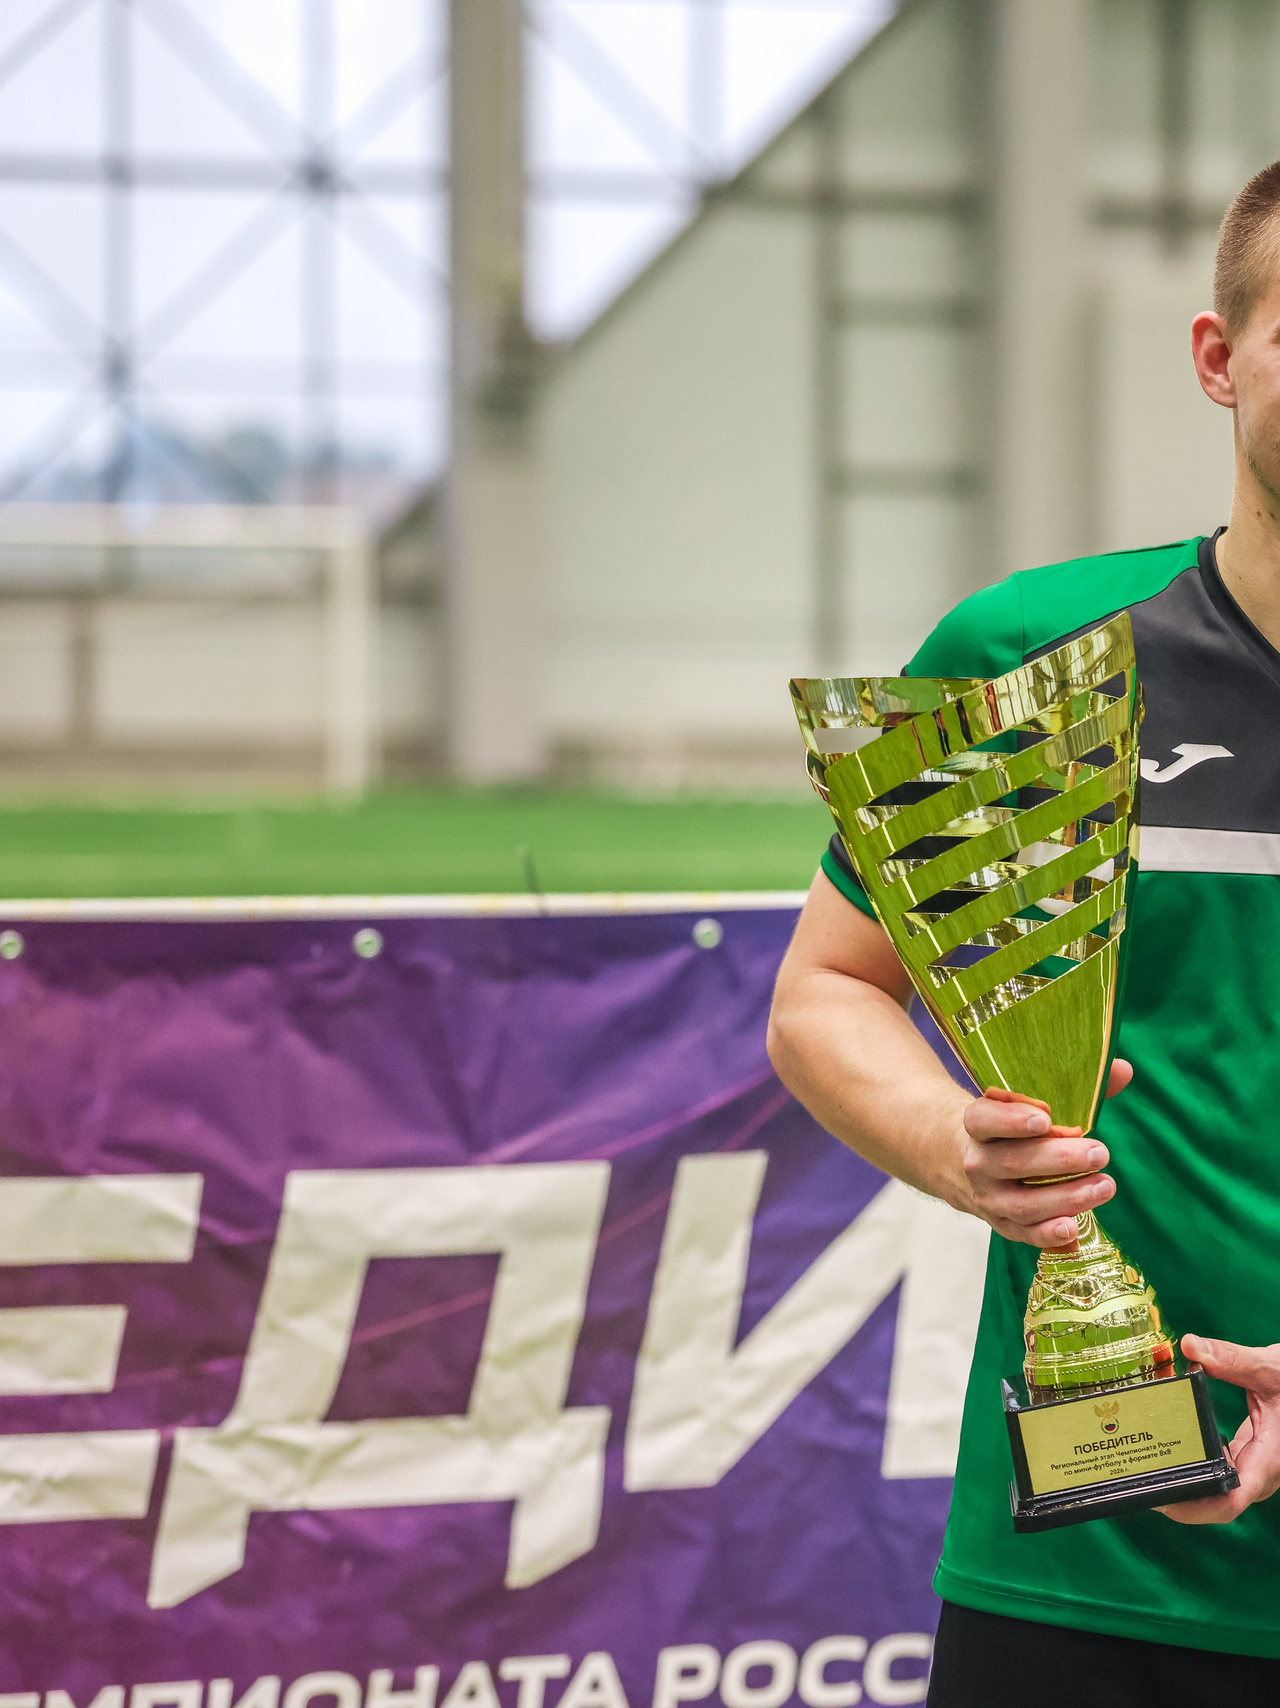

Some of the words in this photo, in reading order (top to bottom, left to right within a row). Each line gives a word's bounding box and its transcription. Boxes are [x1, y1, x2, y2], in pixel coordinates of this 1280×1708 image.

[1050, 1455, 1099, 1470] Региональный
[1099, 1453, 1115, 1461] этап
[1116, 1445, 1157, 1457] Чемпионата
[1158, 1439, 1182, 1448] России
[1073, 1431, 1154, 1456] ПОБЕДИТЕЛЬ
[1074, 1458, 1122, 1475] мини-футболу
[1128, 1452, 1159, 1464] формате
